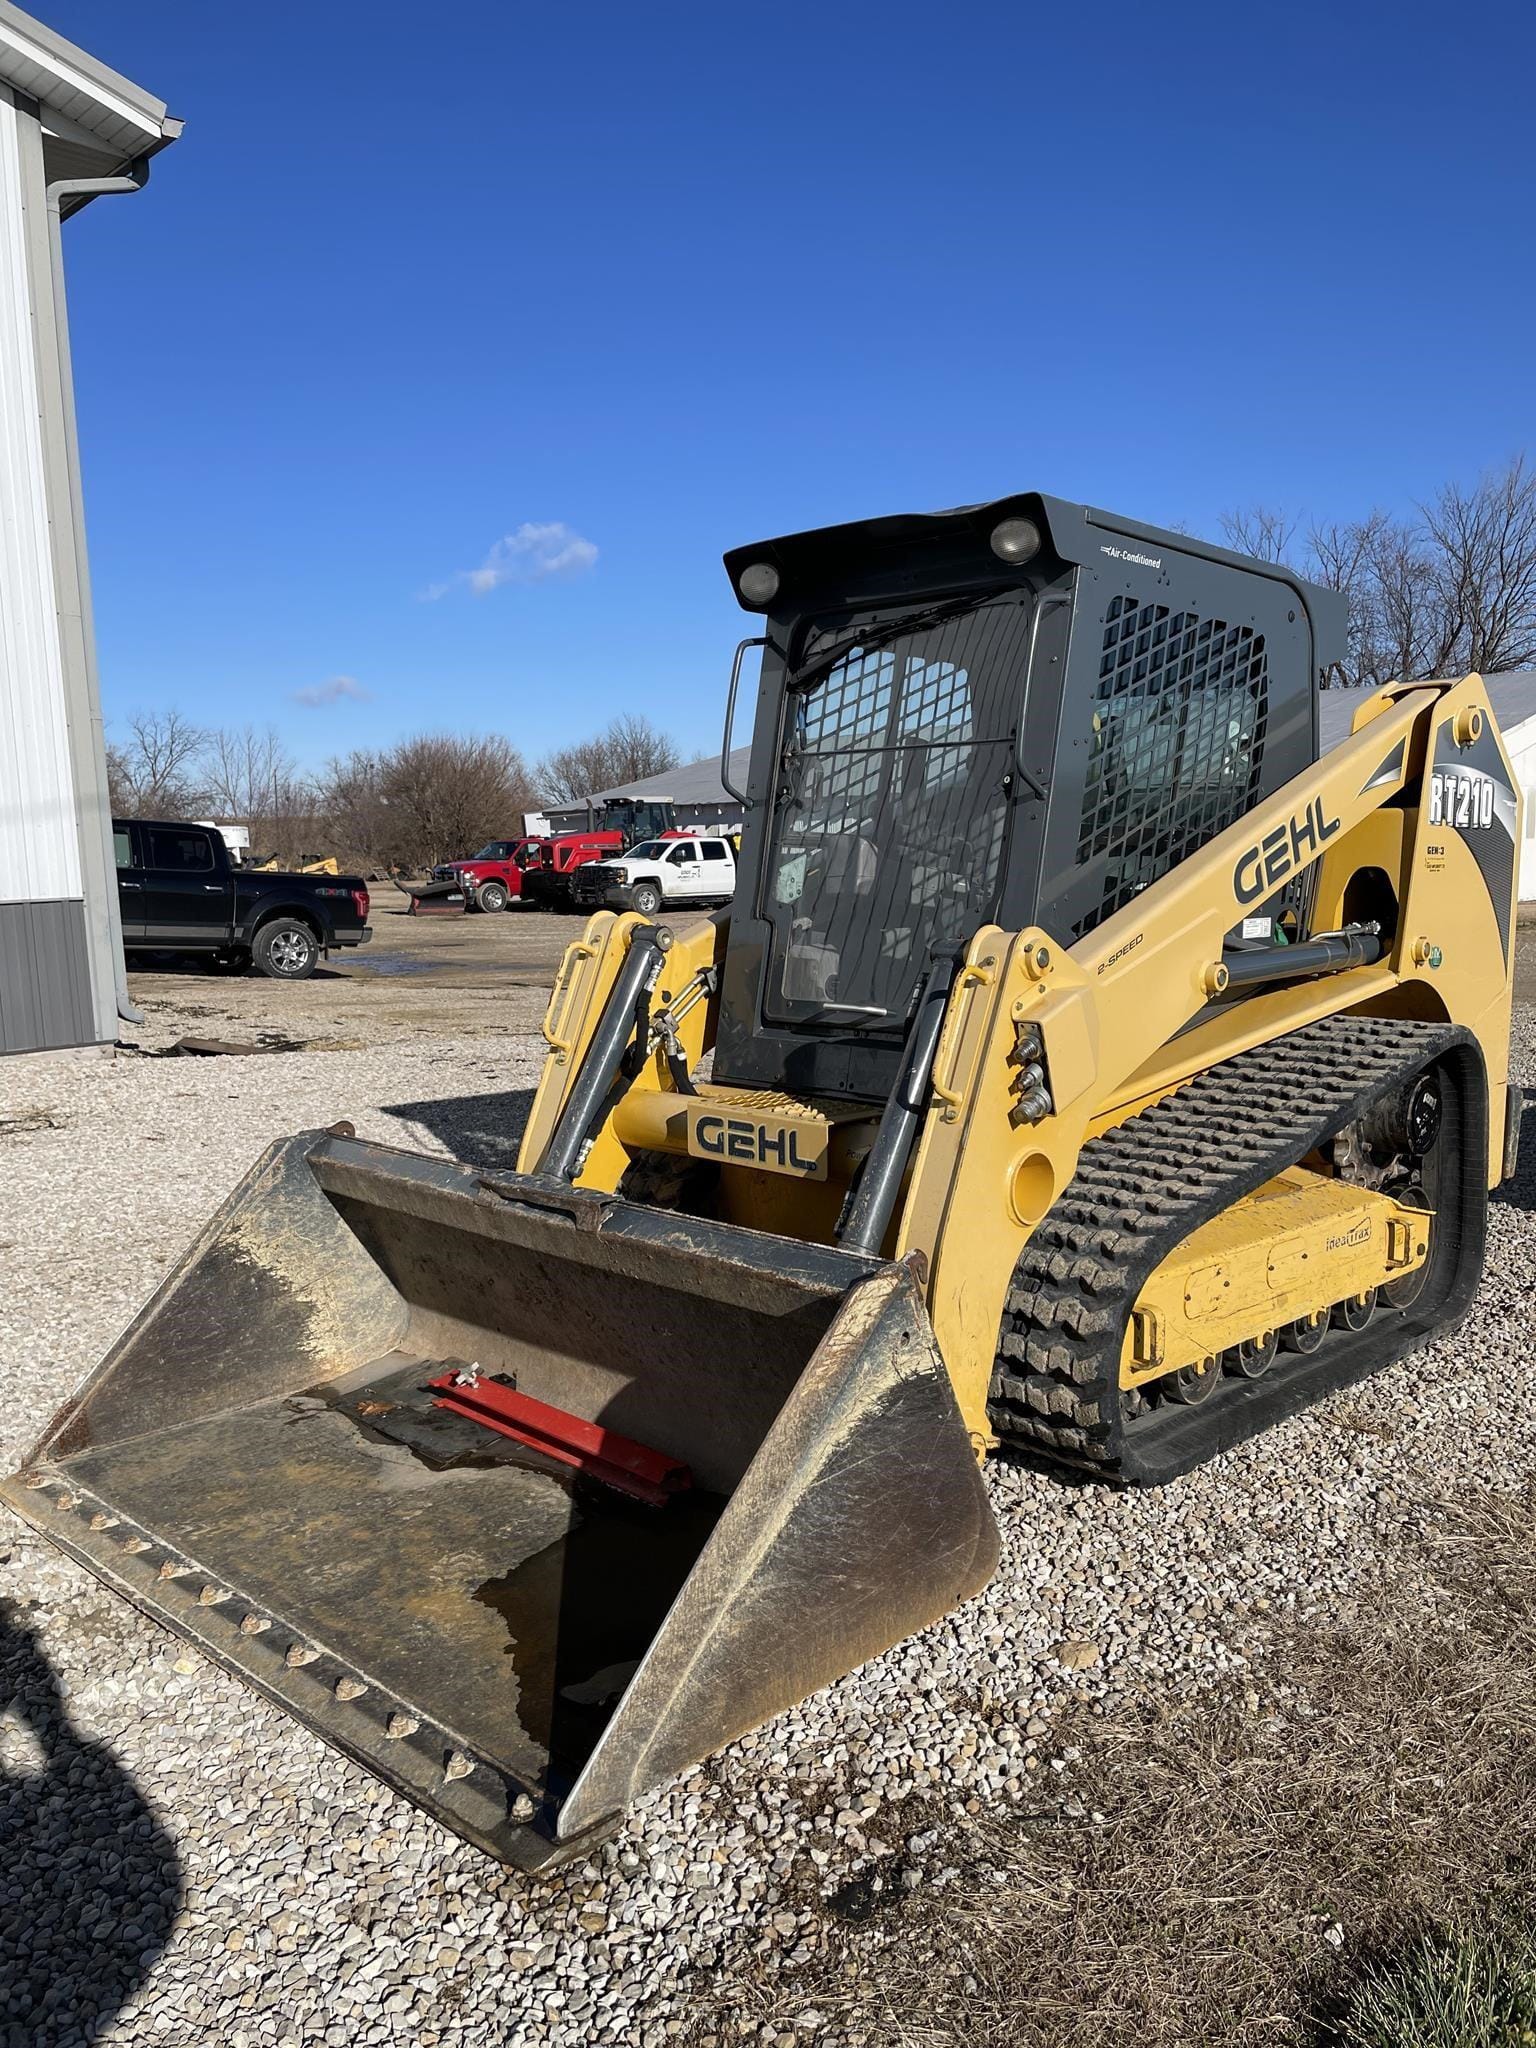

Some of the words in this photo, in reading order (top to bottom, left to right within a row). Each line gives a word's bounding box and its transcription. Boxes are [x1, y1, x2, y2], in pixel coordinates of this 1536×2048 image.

[1110, 547, 1161, 568] Air-Conditioned
[1429, 774, 1494, 829] RT210
[1234, 796, 1341, 905] GEHL
[1098, 933, 1143, 975] 2-SPEED
[696, 1116, 817, 1171] GEHL
